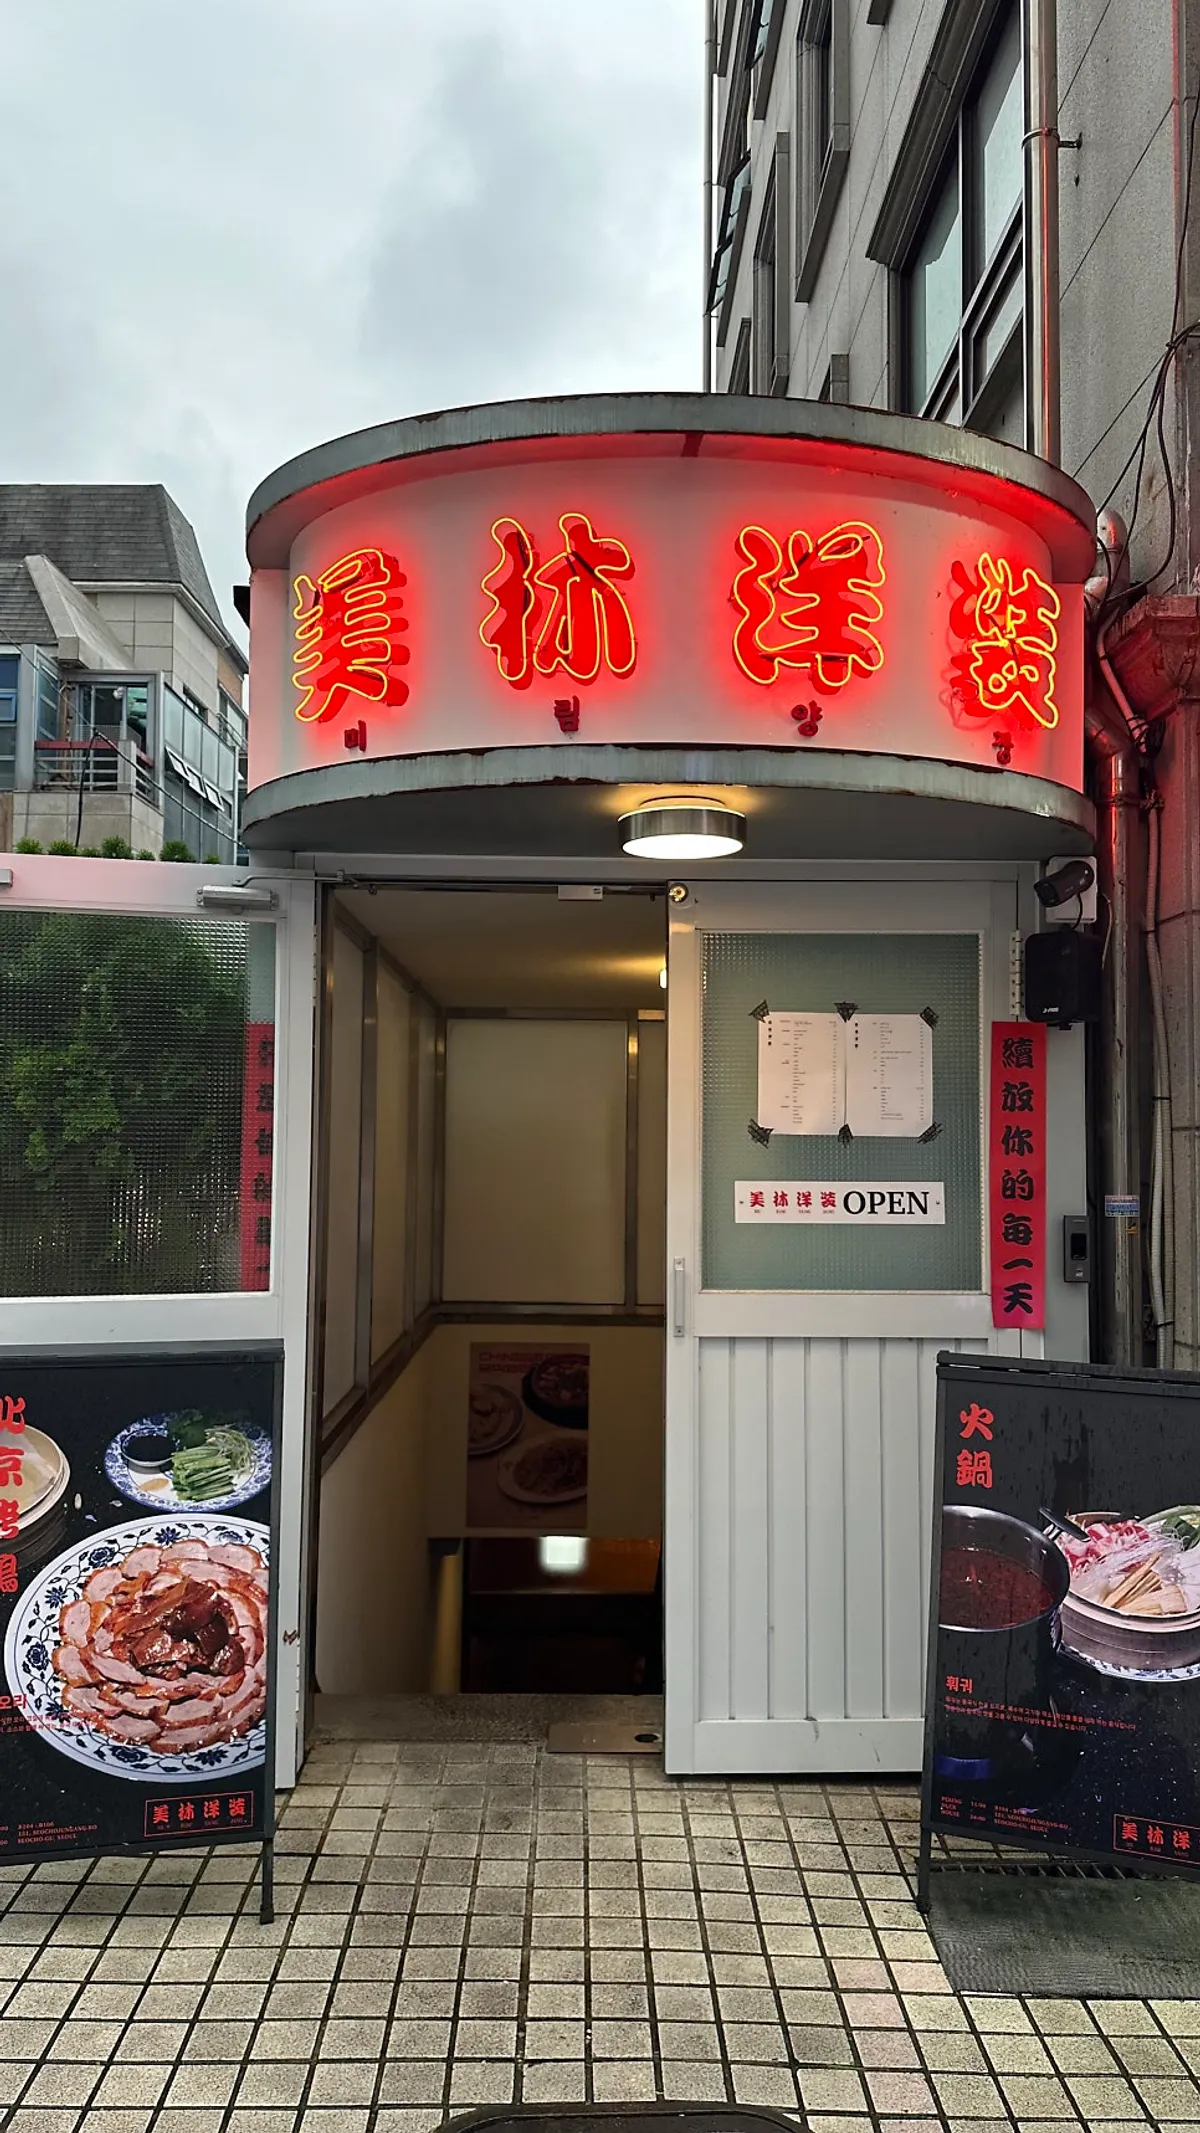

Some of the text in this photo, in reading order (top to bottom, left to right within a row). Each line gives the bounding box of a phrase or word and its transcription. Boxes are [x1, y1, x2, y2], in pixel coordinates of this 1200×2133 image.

[843, 1190, 930, 1215] OPEN
[956, 1403, 994, 1488] 火鍋
[946, 1675, 973, 1694] 훠궈
